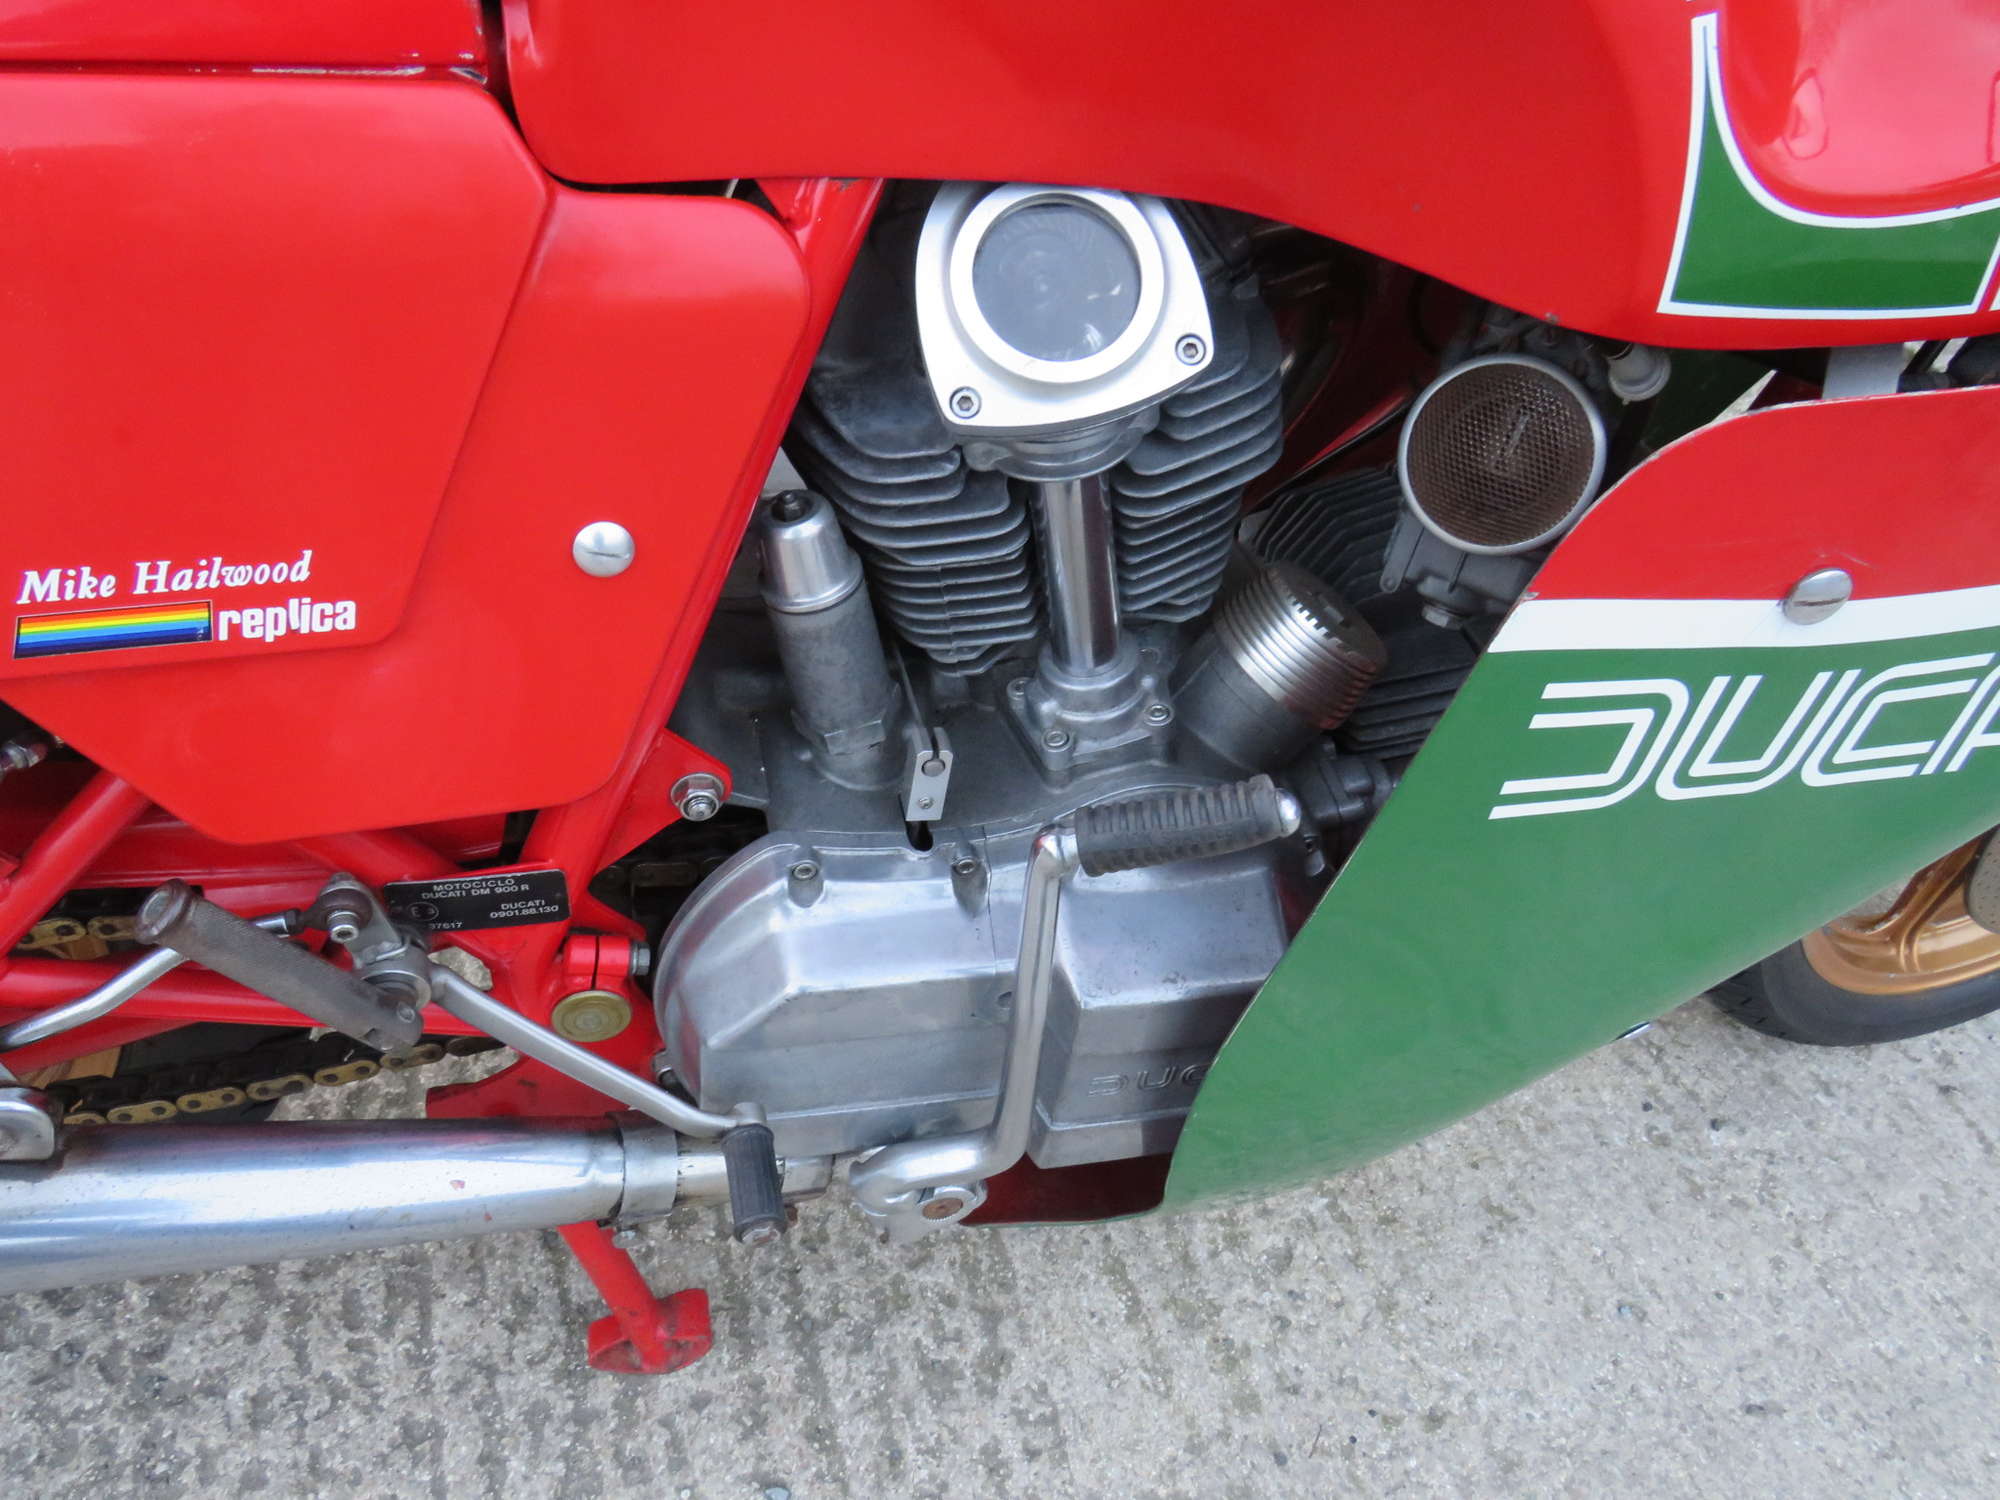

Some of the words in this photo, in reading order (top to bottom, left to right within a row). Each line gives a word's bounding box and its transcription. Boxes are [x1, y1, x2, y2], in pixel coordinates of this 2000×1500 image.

[16, 567, 117, 605] Mike
[132, 550, 313, 594] Hailwood
[218, 598, 357, 642] replica
[421, 890, 467, 900] DUCATI
[472, 888, 490, 896] DM
[494, 885, 519, 894] 900
[521, 884, 530, 892] R
[433, 878, 515, 892] MOTOCICLO
[501, 899, 545, 910] DUCATI
